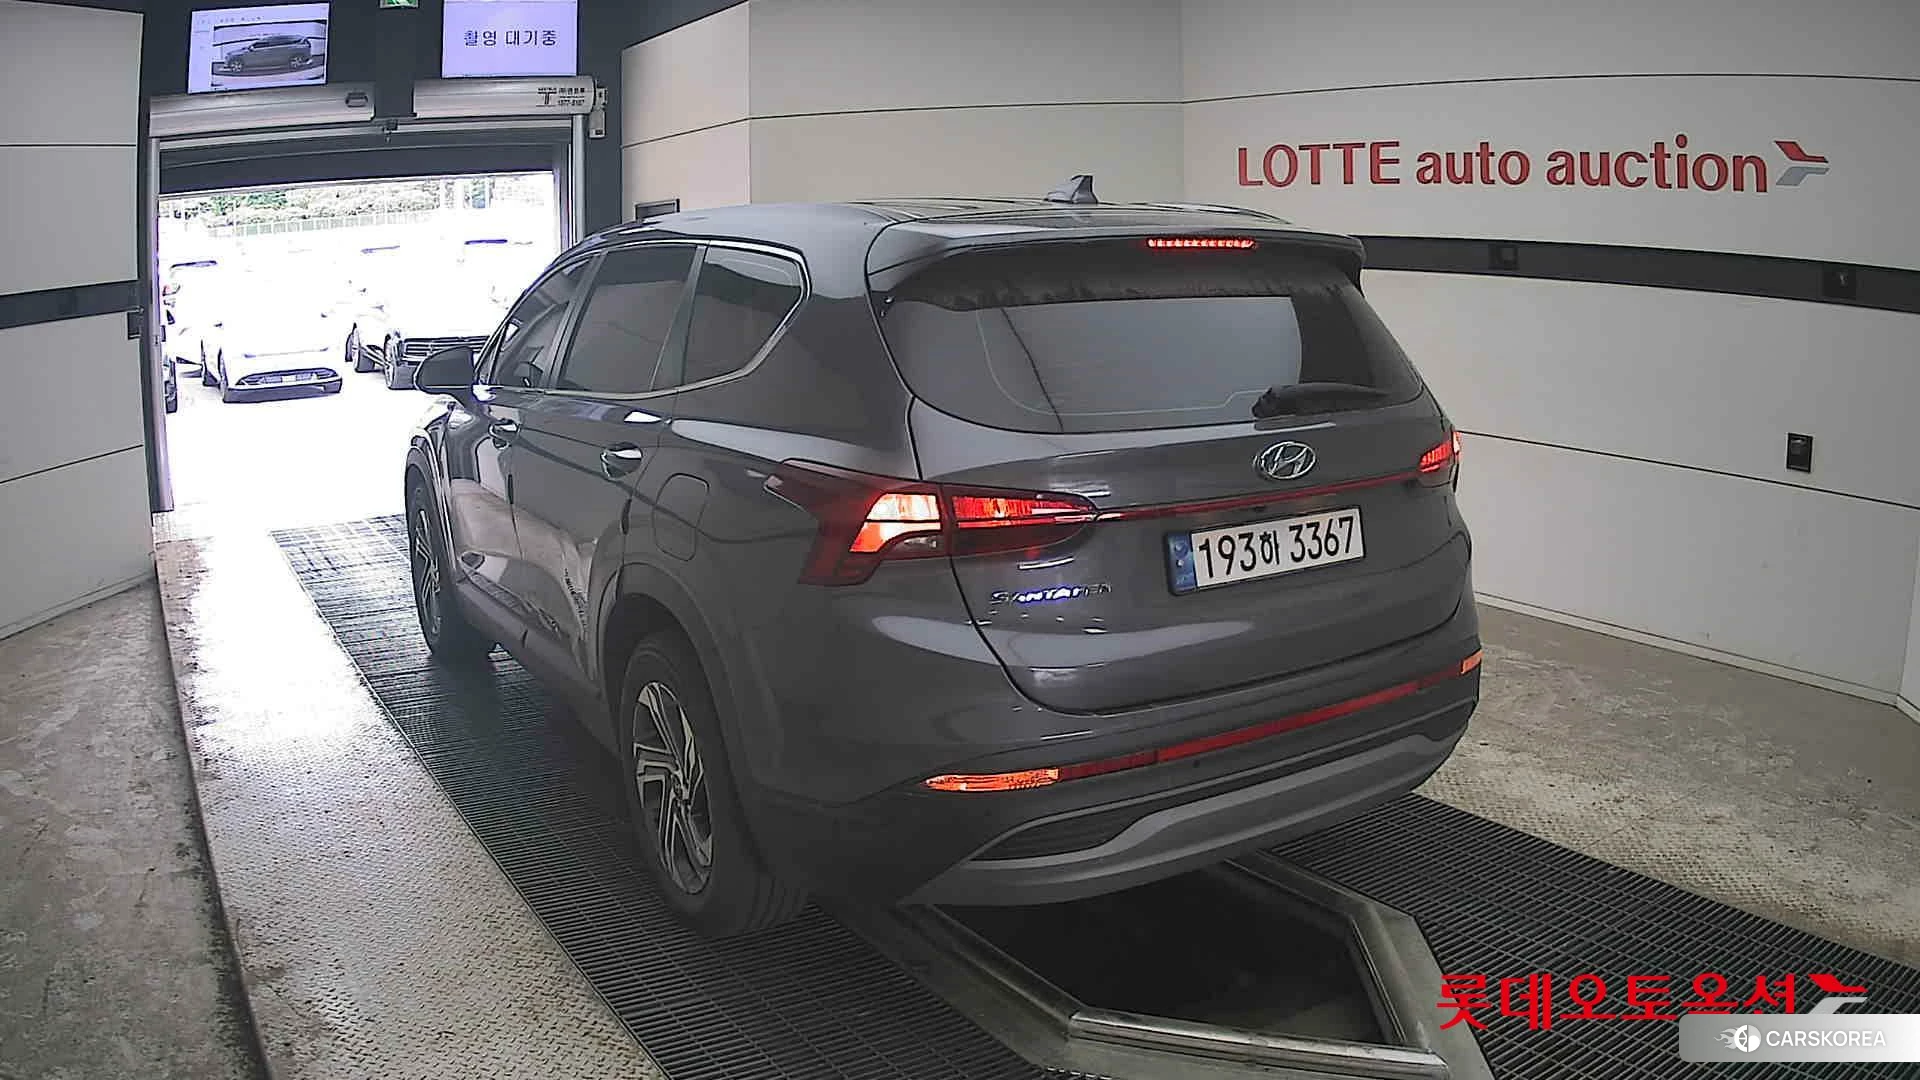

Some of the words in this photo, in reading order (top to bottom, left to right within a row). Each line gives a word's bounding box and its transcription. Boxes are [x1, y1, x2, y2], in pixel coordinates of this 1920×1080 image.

[463, 30, 497, 47] 촬영
[505, 30, 557, 47] 대기중
[1237, 141, 1400, 187] LOTTE
[1415, 141, 1530, 187] auto
[1545, 134, 1769, 193] auction
[1198, 530, 1280, 579] 193하
[1288, 516, 1355, 563] 3367
